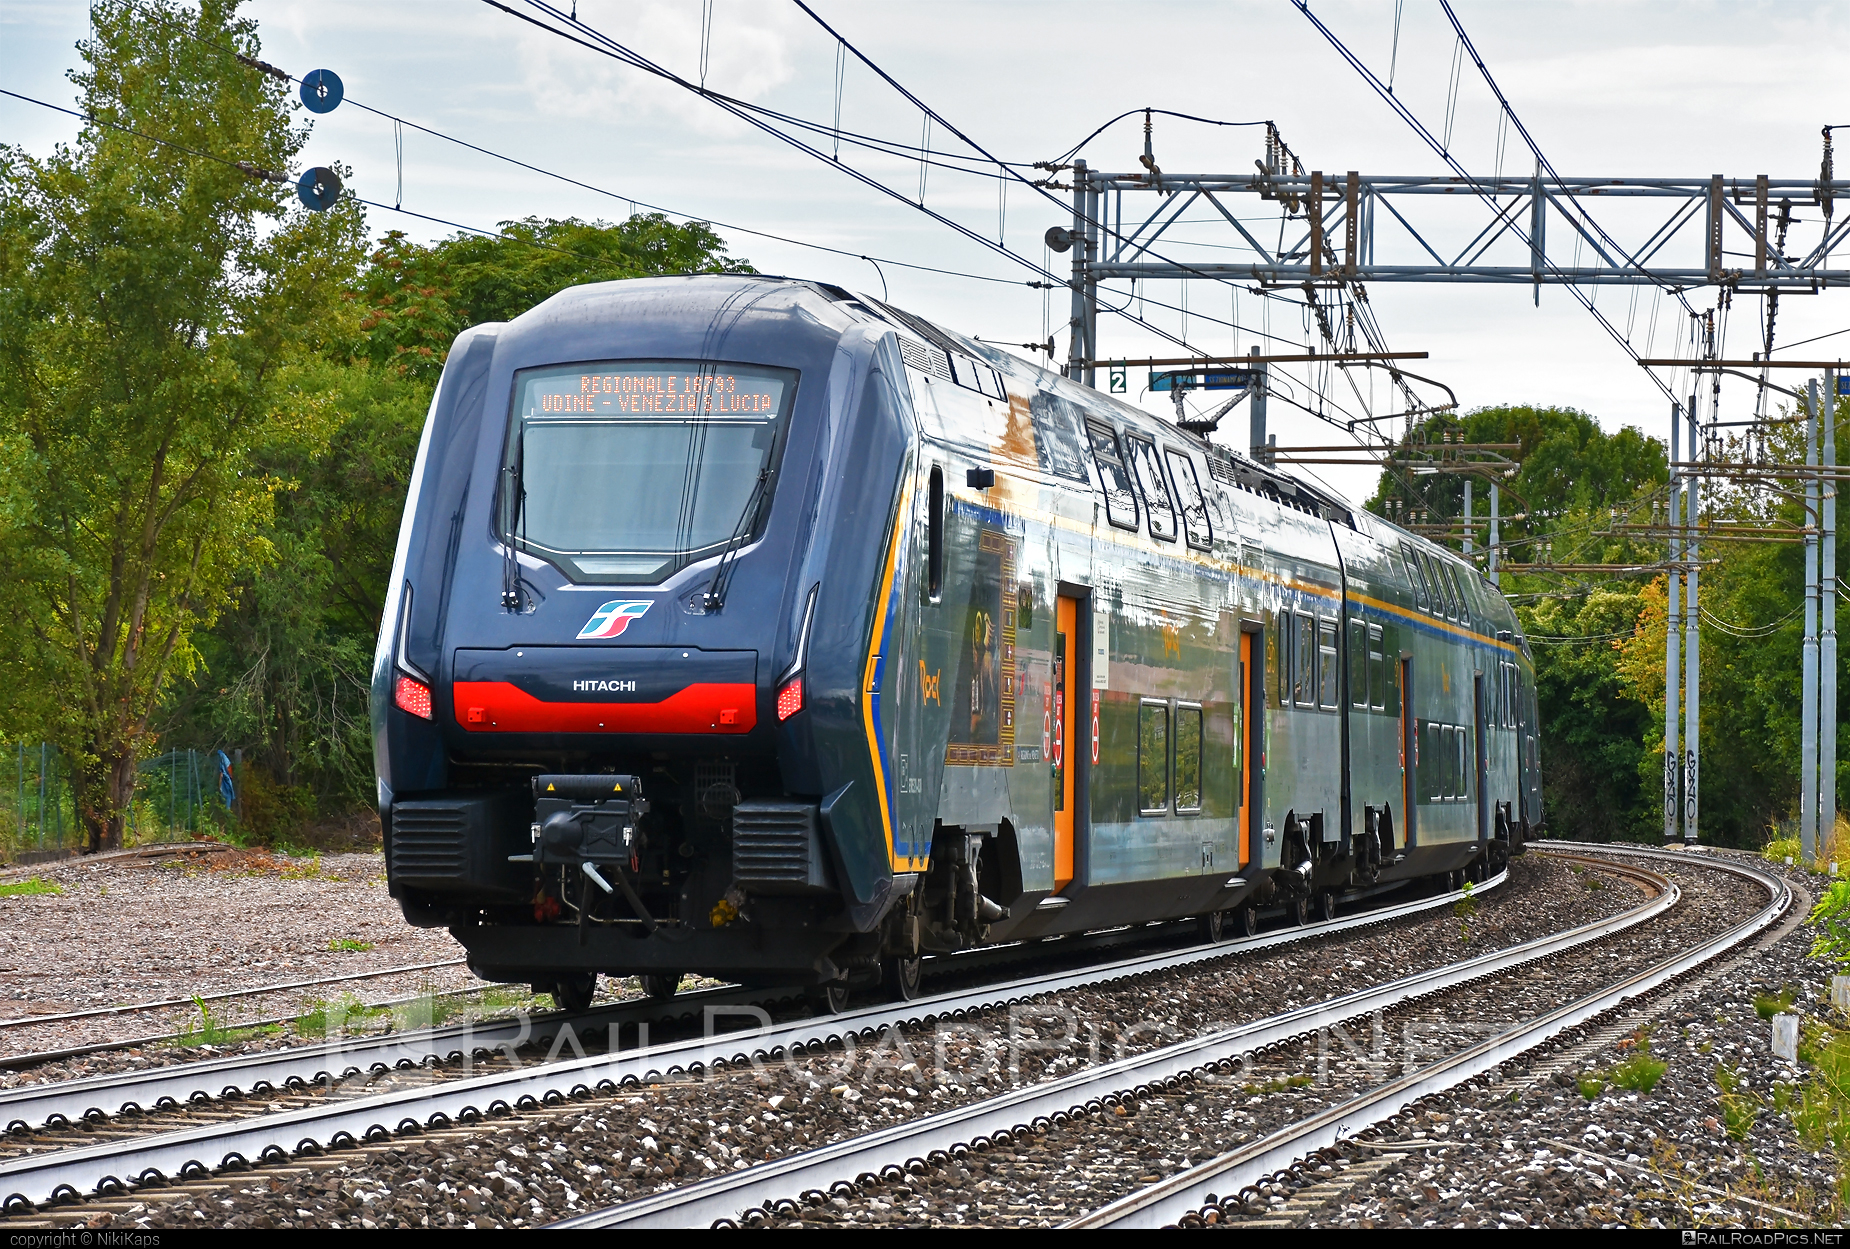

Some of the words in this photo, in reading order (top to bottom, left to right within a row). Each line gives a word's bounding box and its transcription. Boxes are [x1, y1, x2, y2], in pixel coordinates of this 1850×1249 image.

[581, 376, 677, 393] REGIONALE
[684, 376, 735, 393] 16793
[1111, 372, 1125, 393] 2
[542, 394, 595, 412] UDINE
[618, 394, 697, 412] VENEZIA
[703, 394, 771, 412] S.LUCIA
[573, 680, 636, 692] HITACHI
